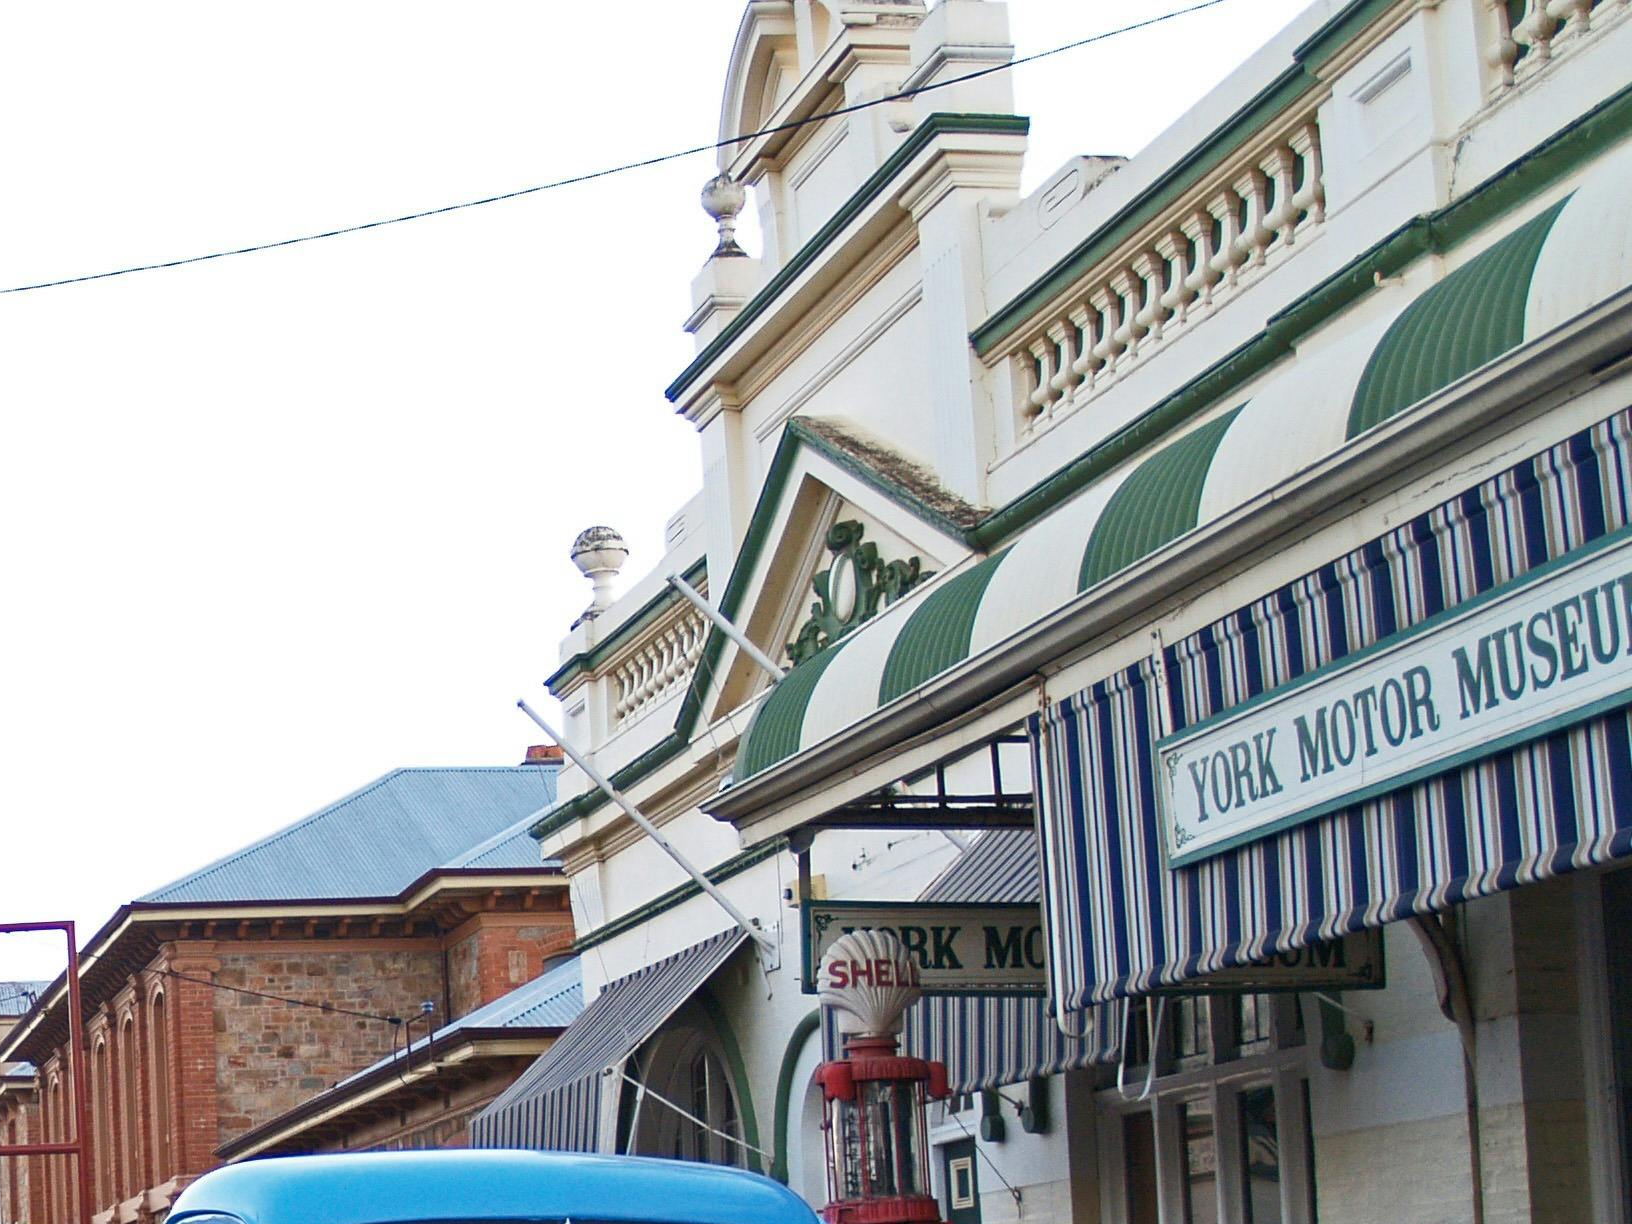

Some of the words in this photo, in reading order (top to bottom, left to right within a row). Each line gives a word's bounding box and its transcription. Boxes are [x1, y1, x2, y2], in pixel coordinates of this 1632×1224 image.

[1188, 727, 1283, 823] YORK
[1293, 665, 1441, 783] MOTOR
[828, 958, 920, 989] SHELL
